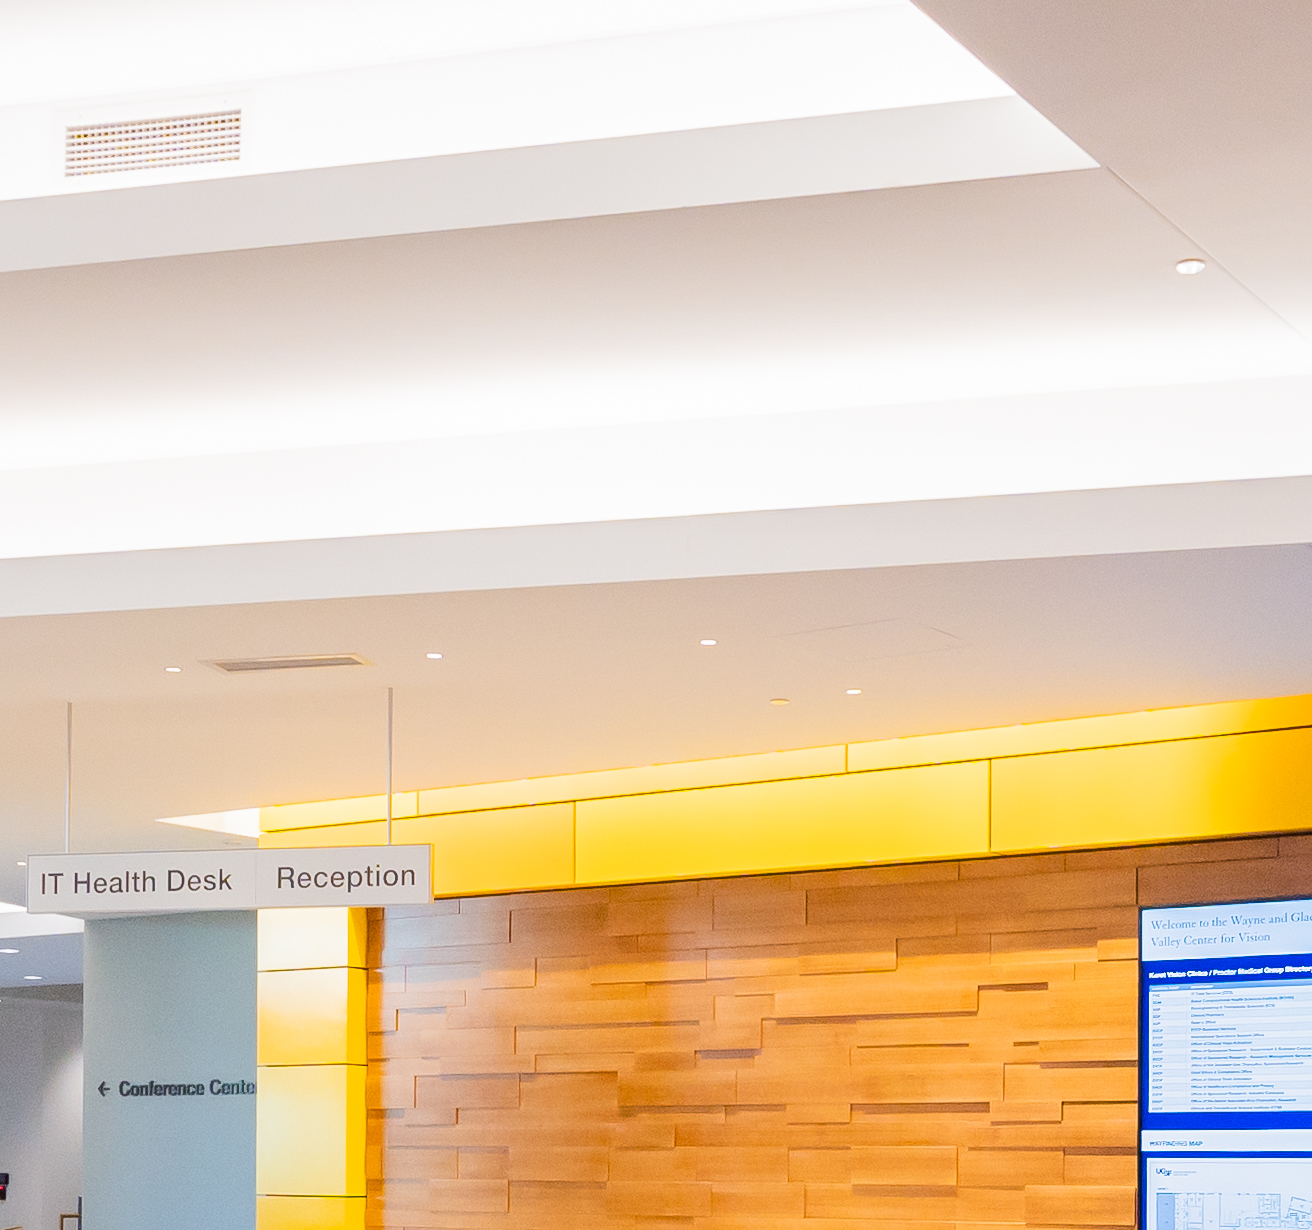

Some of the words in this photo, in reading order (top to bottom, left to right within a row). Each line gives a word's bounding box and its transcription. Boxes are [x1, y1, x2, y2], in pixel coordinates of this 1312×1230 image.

[41, 873, 64, 895] IT
[74, 871, 156, 894] Health
[167, 869, 233, 892] Desk
[277, 864, 416, 893] Reception
[1151, 920, 1197, 930] Welcome
[1212, 917, 1227, 926] the
[1231, 915, 1266, 928] Wayne
[1269, 913, 1288, 924] and
[1152, 937, 1181, 948] Valley
[1184, 936, 1217, 945] Center
[1221, 933, 1235, 943] for
[1238, 932, 1270, 944] Vision
[119, 1081, 205, 1097] Conference
[210, 1079, 256, 1095] Cente
